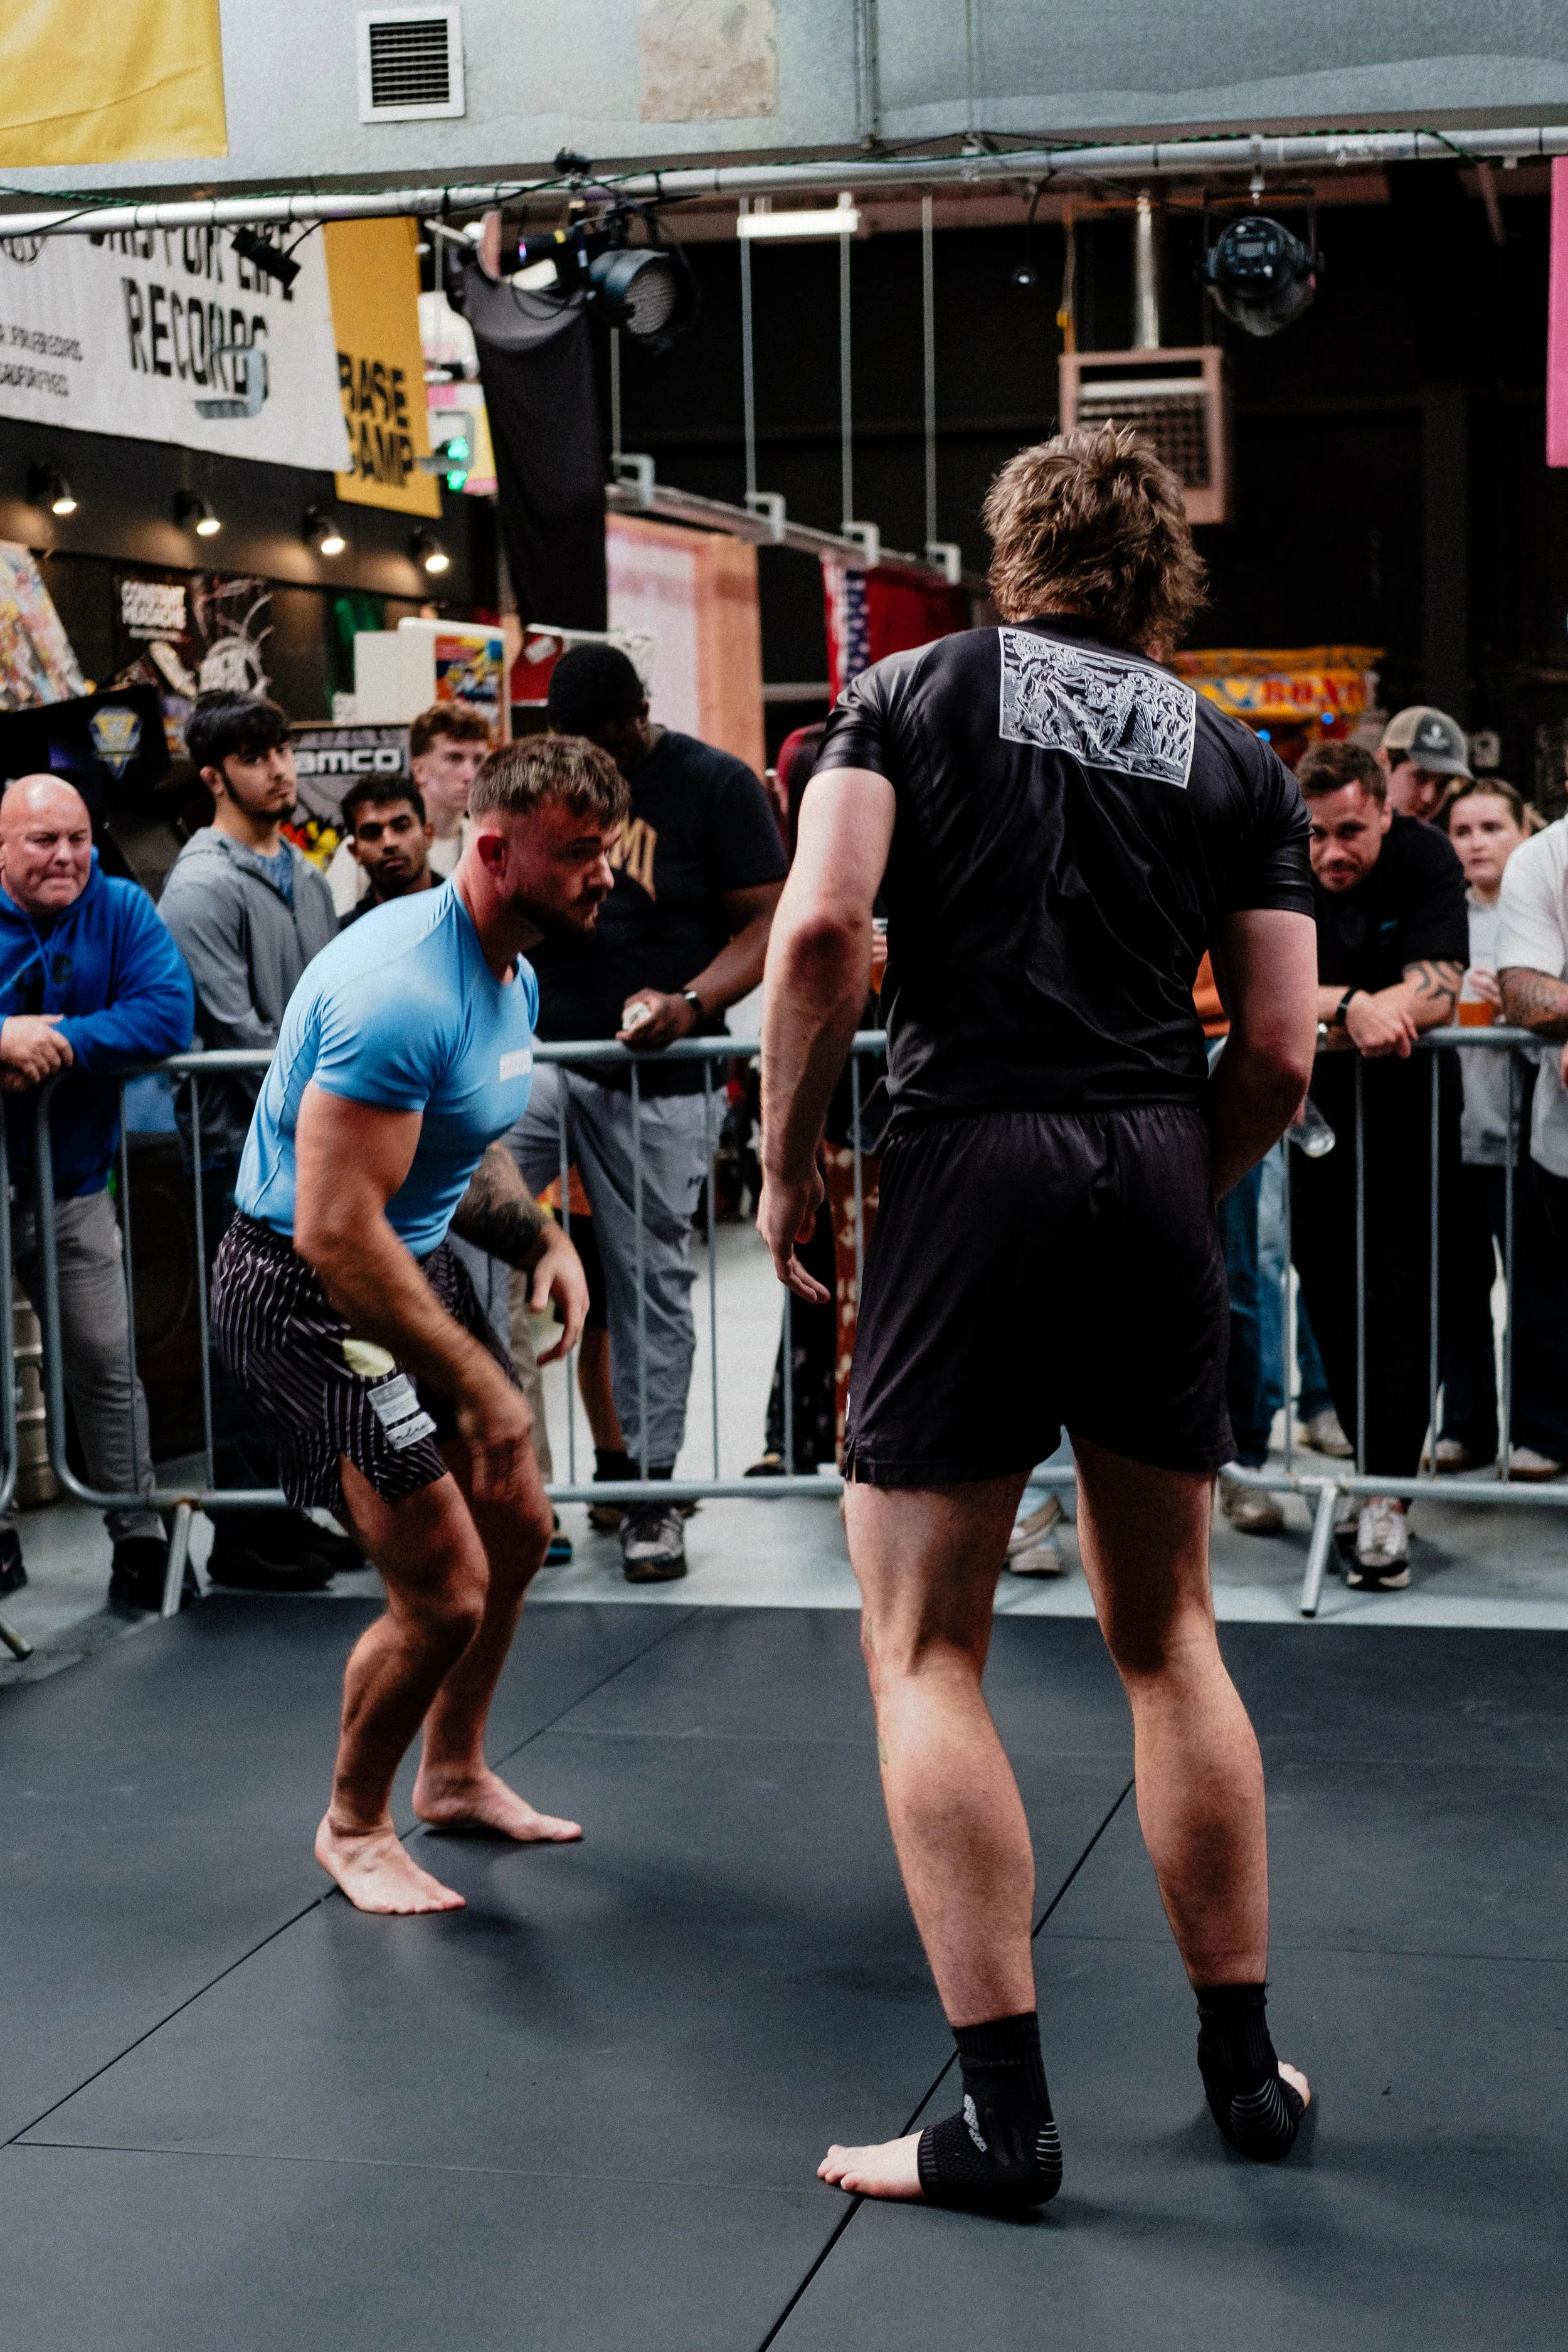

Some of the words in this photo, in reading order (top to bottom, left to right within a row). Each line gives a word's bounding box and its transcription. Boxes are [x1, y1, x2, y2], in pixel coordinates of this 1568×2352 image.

[337, 351, 408, 430] BASE
[345, 416, 414, 488] AMP
[294, 747, 402, 773] amco
